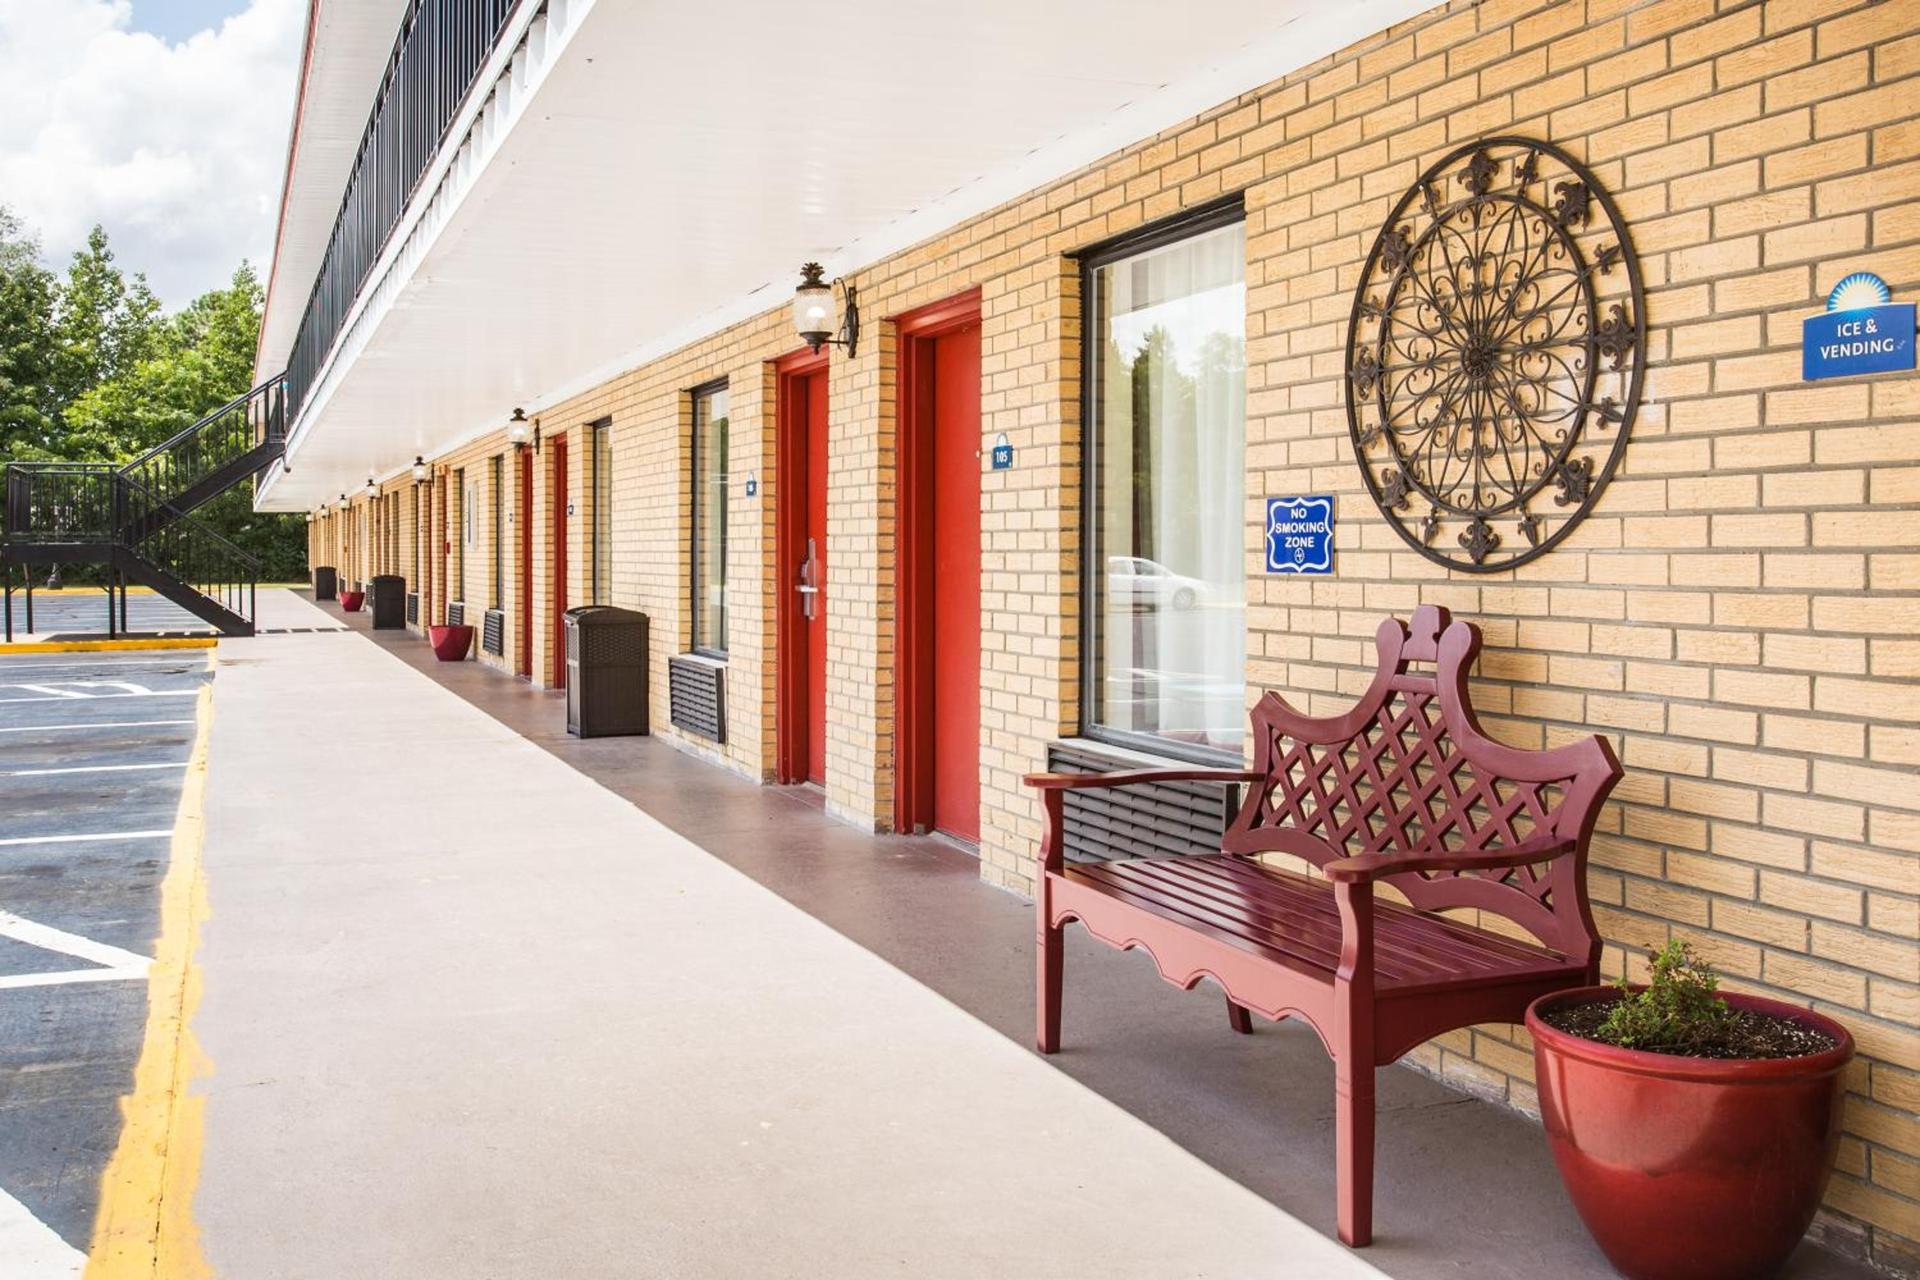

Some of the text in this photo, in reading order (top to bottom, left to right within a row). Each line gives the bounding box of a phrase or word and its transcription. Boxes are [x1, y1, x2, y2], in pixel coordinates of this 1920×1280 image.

[1837, 318, 1878, 337] ICE &
[1820, 338, 1894, 360] VENDING
[996, 450, 1008, 463] 105
[1290, 507, 1307, 519] NO
[1275, 521, 1325, 534] SMOKING
[1284, 536, 1315, 548] ZONE
